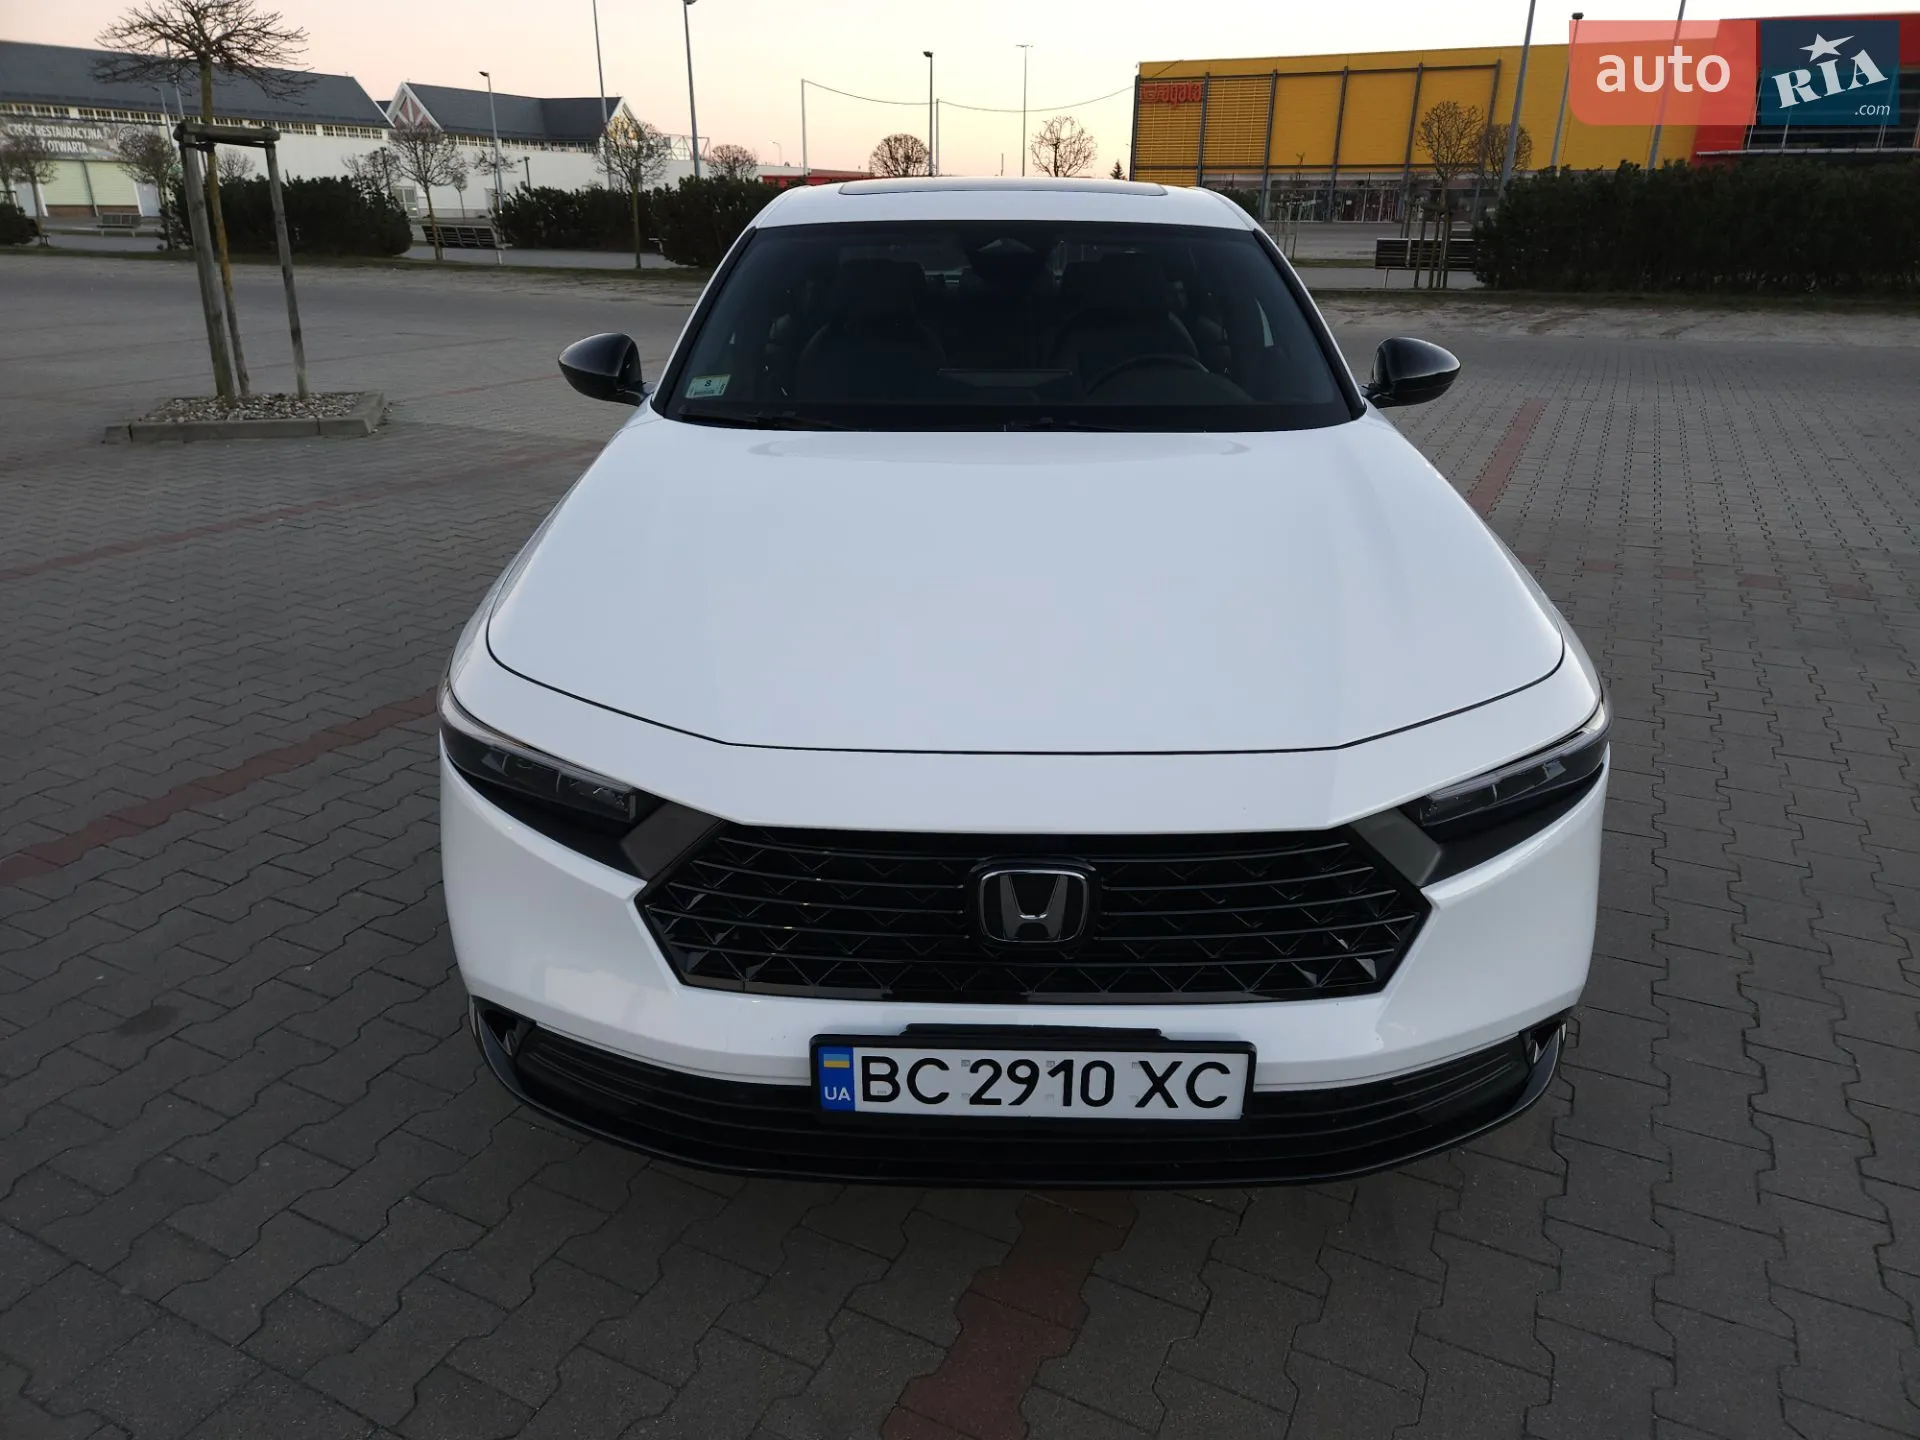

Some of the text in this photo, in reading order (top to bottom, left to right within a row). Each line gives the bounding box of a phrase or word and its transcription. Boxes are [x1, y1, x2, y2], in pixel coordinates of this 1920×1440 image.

[35, 125, 103, 140] RESTAURACYJNA
[47, 140, 89, 154] OTWARTA
[861, 1055, 1231, 1109] BC 2910 XC
[824, 1086, 851, 1102] UA
